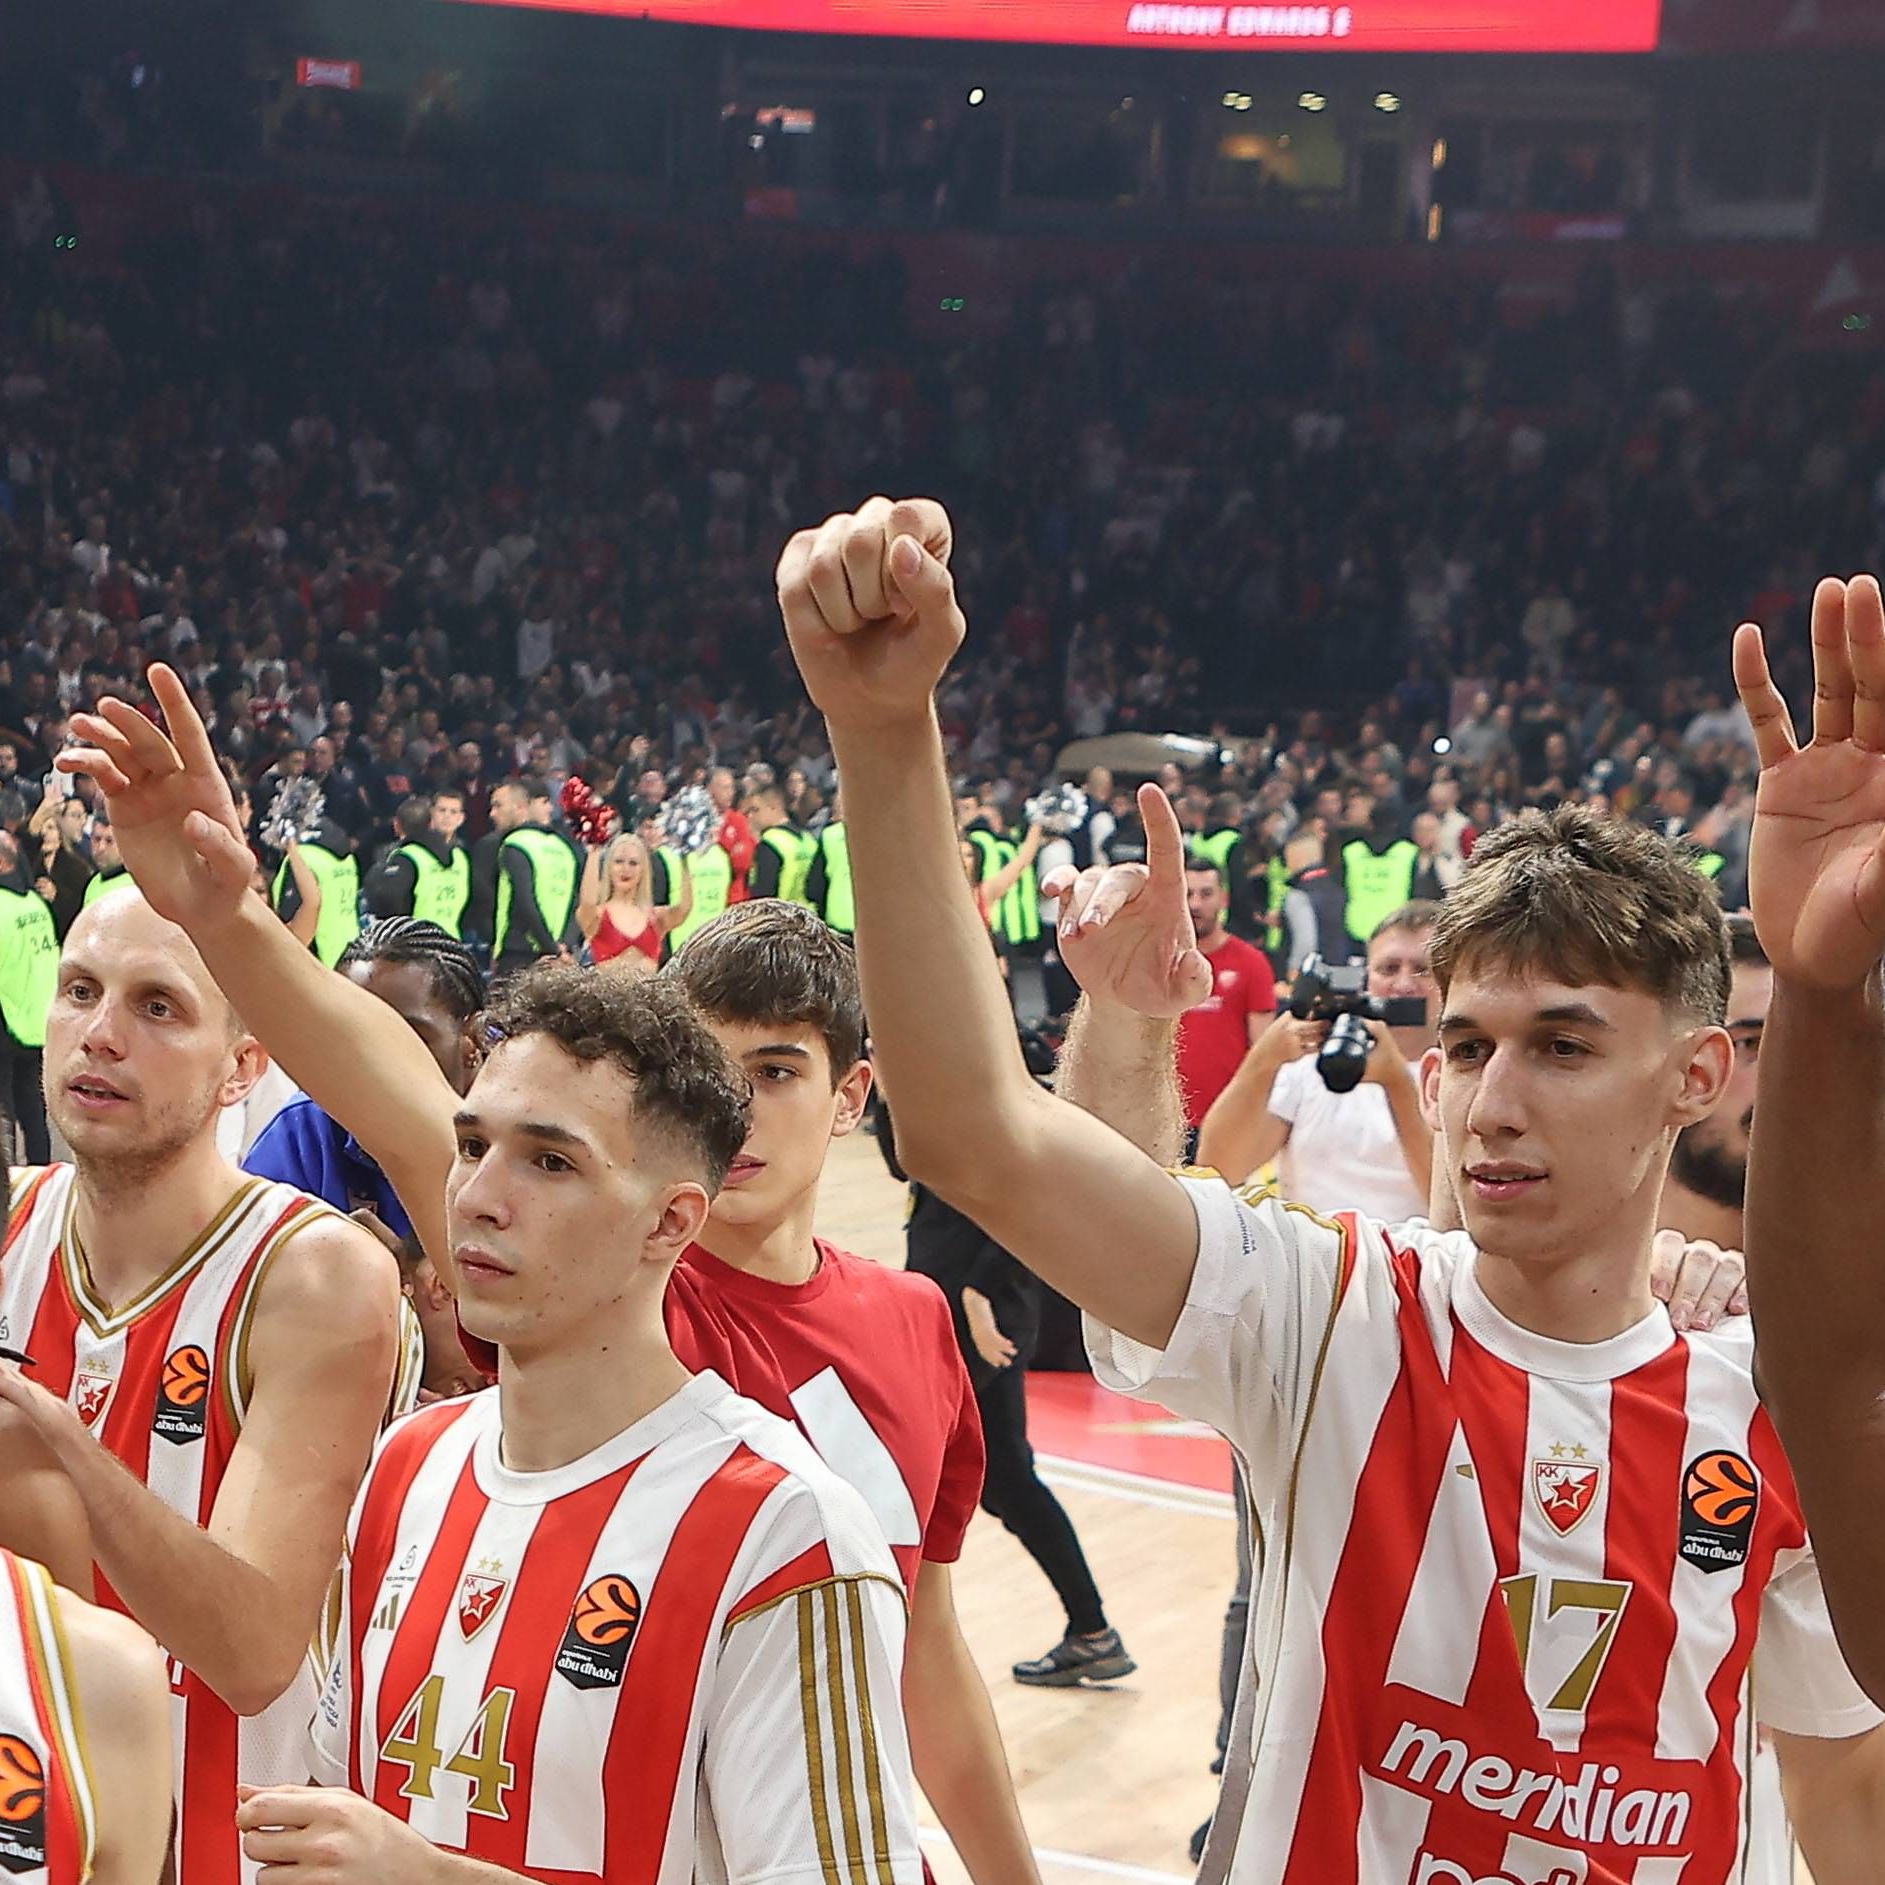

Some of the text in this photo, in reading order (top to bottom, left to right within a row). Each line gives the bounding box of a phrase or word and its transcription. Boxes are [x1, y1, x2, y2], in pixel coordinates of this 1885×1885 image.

[1683, 1543, 1745, 1562] abu dhabi
[557, 1657, 619, 1683] abu dhabi
[1501, 1572, 1632, 1713] 17
[381, 1674, 517, 1822] 44
[1381, 1721, 1689, 1845] meridian
